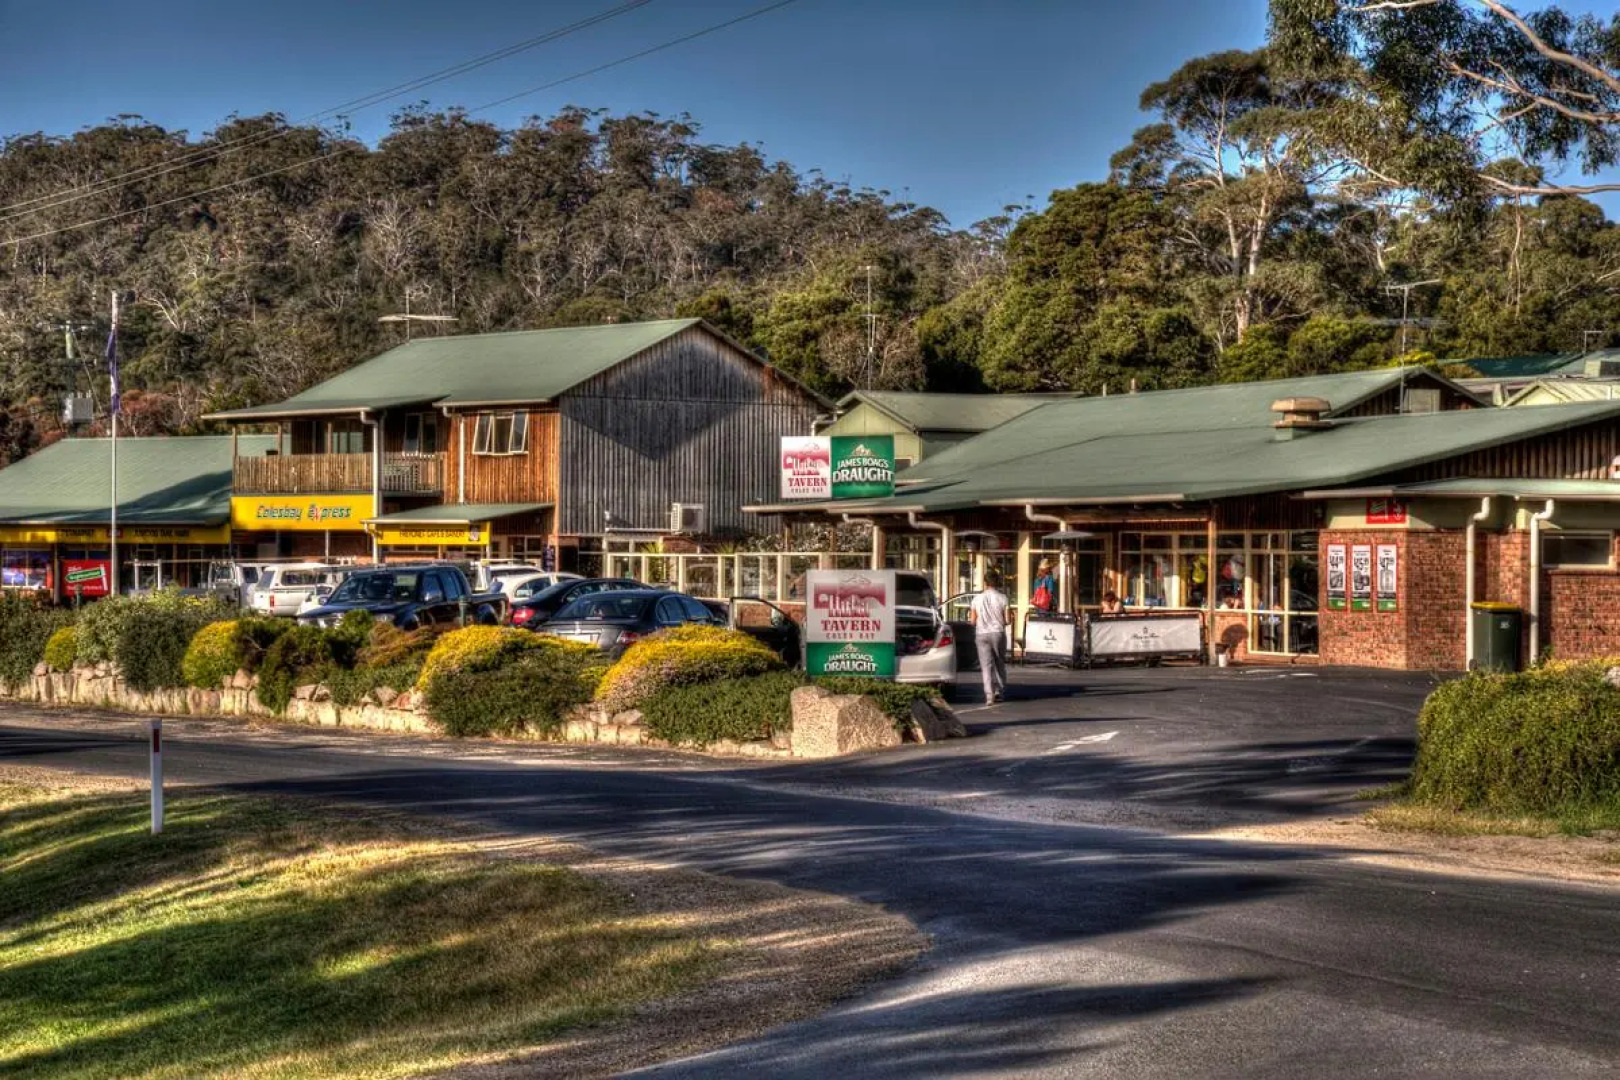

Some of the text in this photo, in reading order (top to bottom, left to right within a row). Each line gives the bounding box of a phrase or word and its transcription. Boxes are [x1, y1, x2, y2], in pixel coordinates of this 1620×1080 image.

[837, 458, 860, 469] JAMES
[833, 467, 894, 482] DRAUGHT
[788, 477, 827, 487] TAVERN
[821, 619, 881, 631] TAVERN
[829, 652, 849, 661] JAMES
[824, 661, 878, 672] DRAUGHT
